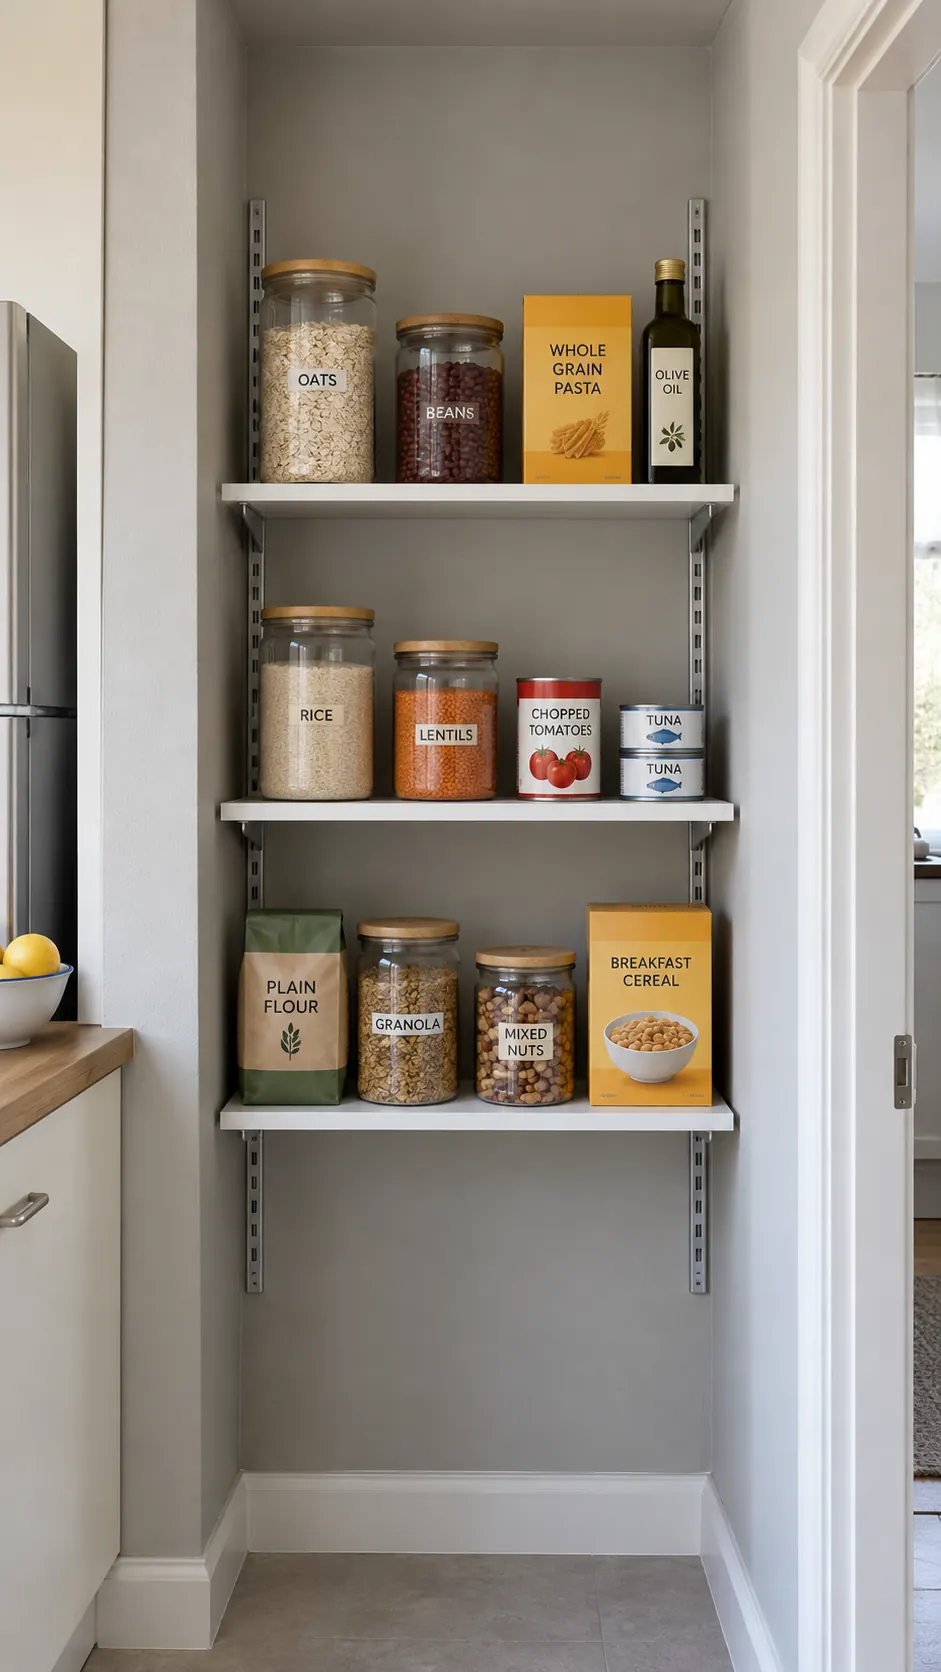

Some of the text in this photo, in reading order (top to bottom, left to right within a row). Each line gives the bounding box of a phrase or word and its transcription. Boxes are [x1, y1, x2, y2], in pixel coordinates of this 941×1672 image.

[549, 344, 606, 357] WHOLE
[552, 363, 603, 376] GRAIN
[655, 369, 689, 380] OLIVE
[298, 373, 337, 387] OATS
[554, 381, 602, 395] PASTA
[662, 384, 682, 394] OIL
[426, 406, 475, 420] BEANS
[300, 709, 333, 722] RICE
[531, 708, 590, 720] CHOPPED
[647, 715, 682, 726] TUNA
[420, 728, 473, 742] LENTILS
[529, 724, 592, 736] TOMATOES
[647, 763, 682, 775] TUNA
[610, 956, 692, 970] BREAKFAST
[623, 973, 680, 987] CEREAL
[266, 980, 317, 995] PLAIN
[264, 999, 319, 1014] FLOUR
[375, 1017, 441, 1032] GRANOLA
[504, 1027, 547, 1040] MIXED
[507, 1043, 545, 1057] NUTS
